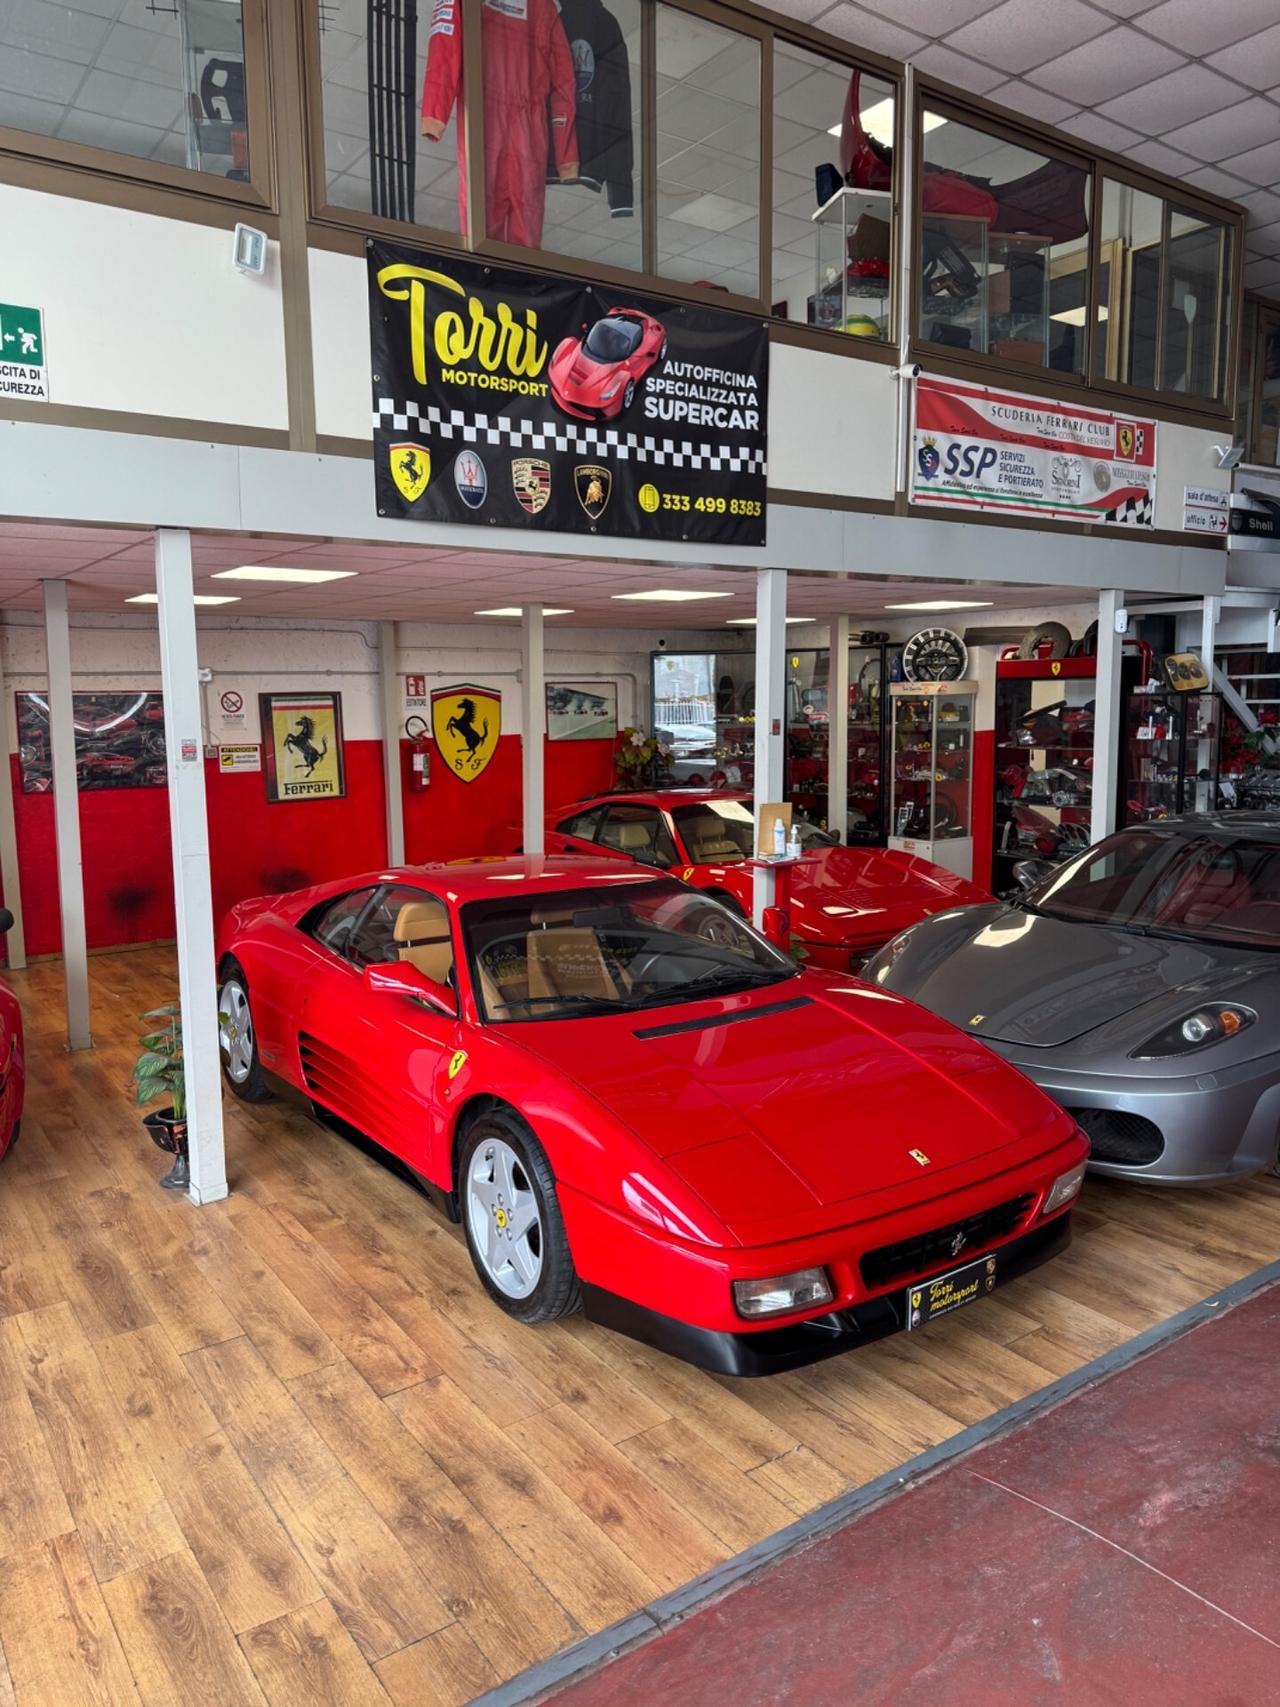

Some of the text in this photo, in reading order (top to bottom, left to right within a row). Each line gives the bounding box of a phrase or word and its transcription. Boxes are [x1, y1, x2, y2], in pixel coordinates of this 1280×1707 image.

[377, 264, 548, 385] Torri
[0, 365, 41, 380] CITA DI
[441, 368, 549, 397] MOTORSPORT
[663, 360, 758, 389] AUTOFFICINA
[645, 377, 759, 407] SPECIALIZZATA
[644, 396, 759, 431] SUPERCAR
[991, 406, 1043, 424] SCUDERIA
[1046, 415, 1083, 432] FERRARI
[1087, 423, 1110, 437] CLUB
[513, 459, 550, 469] PORSCHE
[943, 442, 998, 479] SSP
[1000, 450, 1026, 463] SERVIZI
[999, 462, 1036, 476] SICUREZZA
[998, 473, 1003, 483] E
[1004, 474, 1045, 489] PORTIERATO
[662, 493, 762, 517] 333 499 8383
[1186, 513, 1206, 525] ufficio
[1248, 518, 1274, 532] Shell
[283, 780, 334, 796] Ferrari
